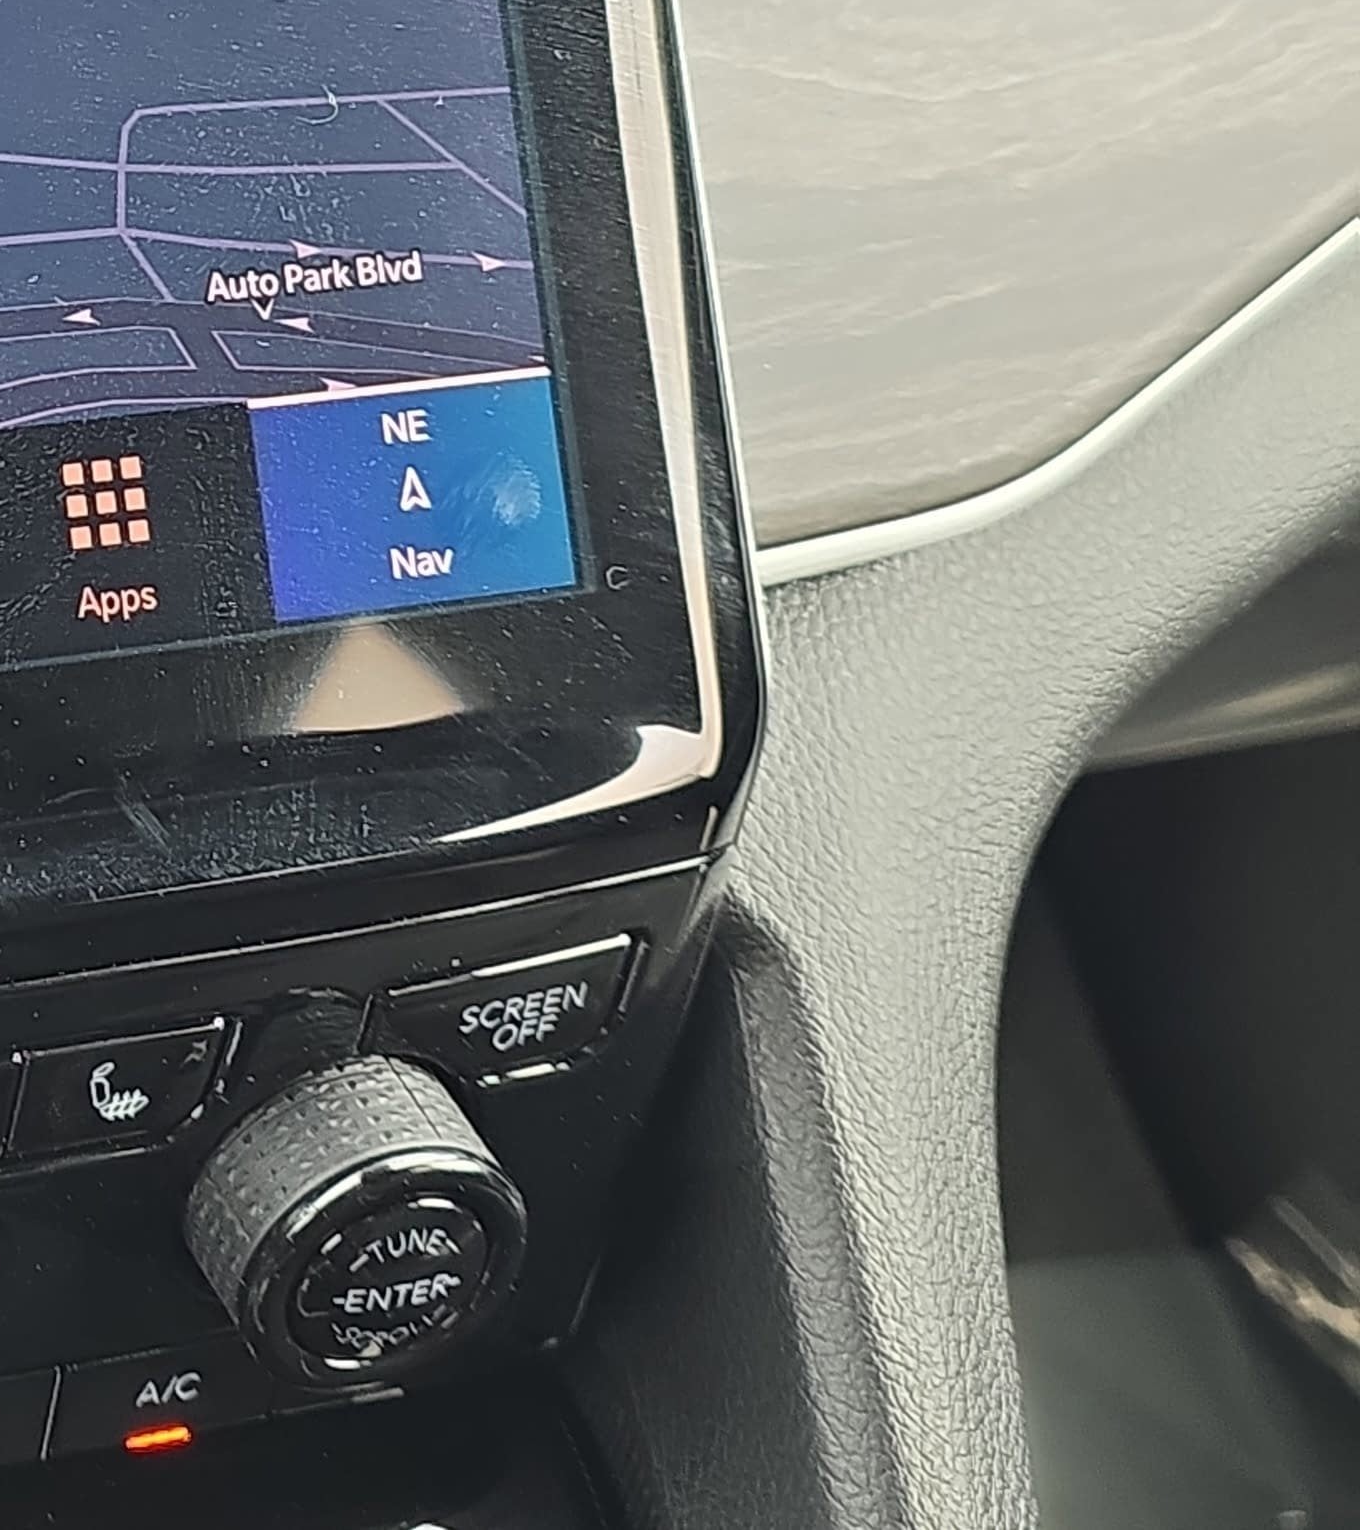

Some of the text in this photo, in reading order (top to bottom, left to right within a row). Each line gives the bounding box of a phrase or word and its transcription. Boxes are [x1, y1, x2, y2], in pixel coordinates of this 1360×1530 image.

[206, 251, 422, 303] Auto Park Blvd
[381, 410, 432, 444] NE
[390, 546, 455, 581] Nav
[77, 583, 158, 623] Apps
[458, 981, 588, 1035] SCREEN
[492, 1013, 560, 1051] OFF
[135, 1371, 202, 1408] A/C
